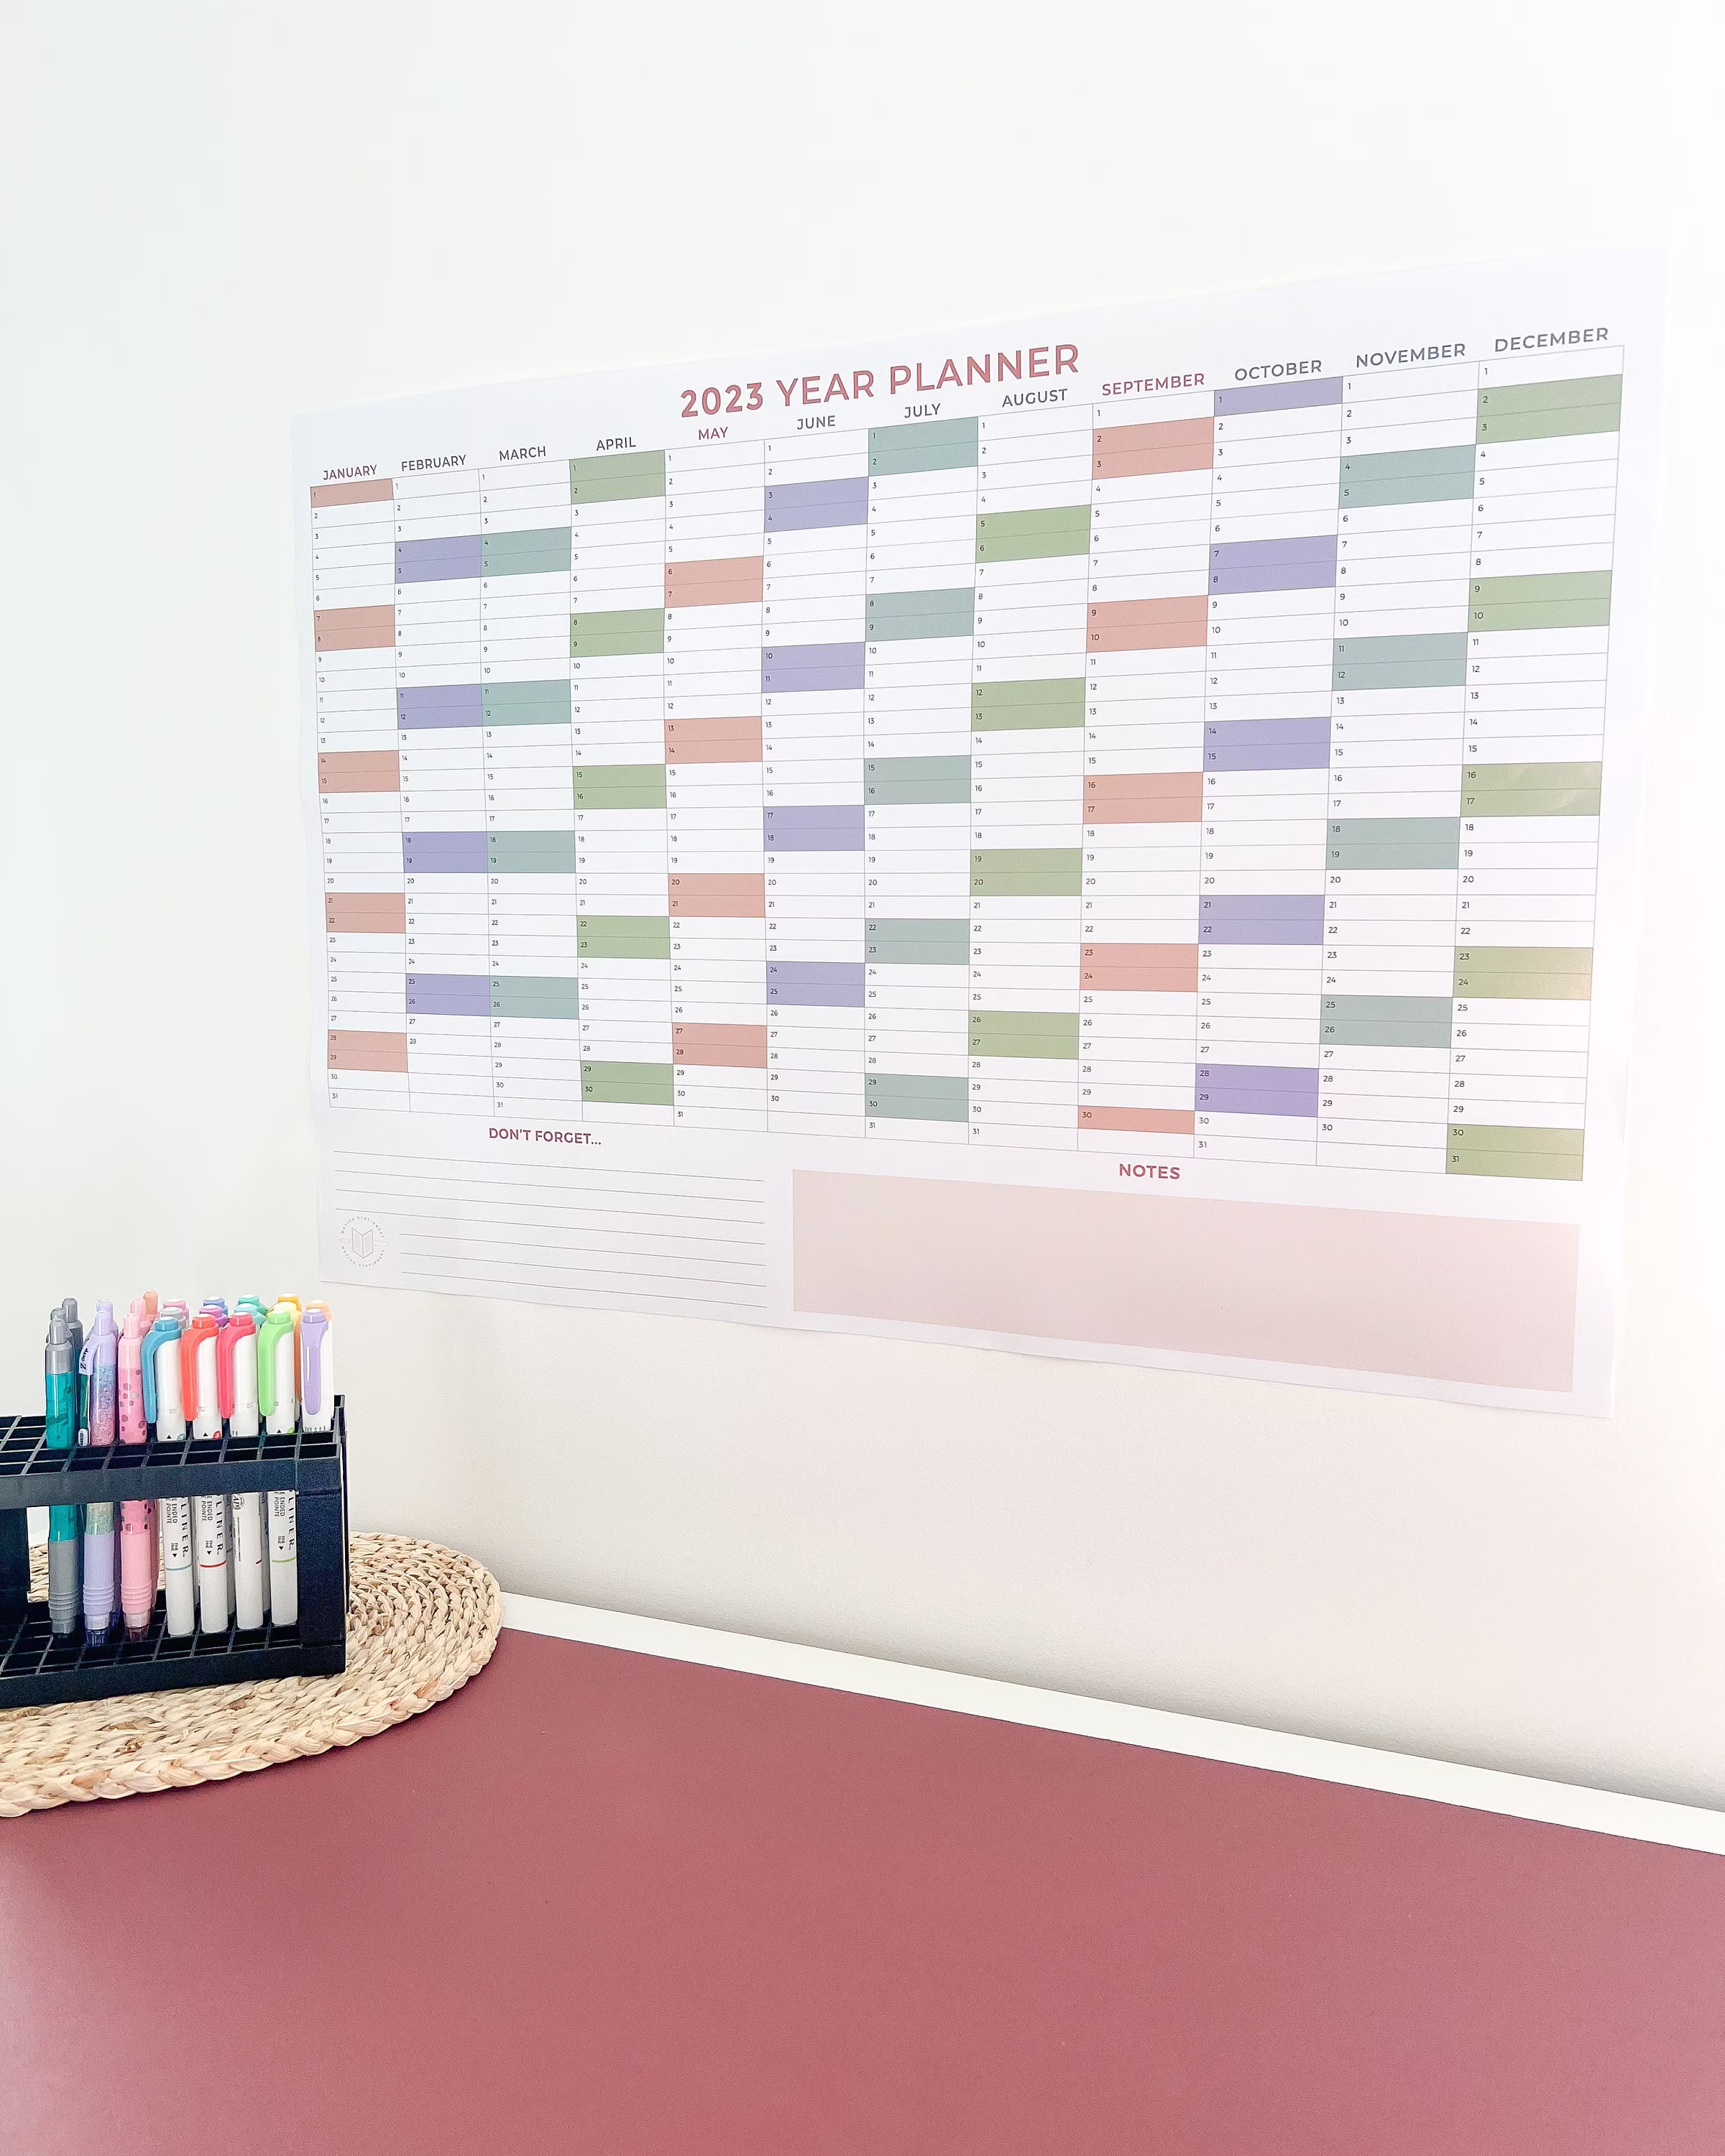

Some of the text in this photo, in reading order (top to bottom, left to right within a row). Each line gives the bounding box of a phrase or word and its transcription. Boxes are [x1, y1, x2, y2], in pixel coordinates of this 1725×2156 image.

[1494, 327, 1609, 353] DECEMBER
[1356, 343, 1466, 369] NOVEMBER
[1234, 359, 1323, 382] OCTOBER
[680, 344, 1080, 418] 2023 YEAR PLANNER
[1102, 373, 1205, 397] SEPTEMBER
[1001, 388, 1068, 408] AUGUST
[904, 402, 942, 419] JULY
[796, 415, 836, 430] JUNE
[698, 426, 728, 441] MAY
[596, 436, 637, 451] APRIL
[499, 446, 546, 461] MARCH
[401, 454, 466, 472] FEBRUARY
[323, 464, 378, 481] JANUARY
[1478, 477, 1485, 486] 5
[1215, 499, 1222, 507] 5
[1475, 558, 1481, 566] 8
[1336, 696, 1345, 705] 13
[1328, 926, 1338, 934] 22
[1457, 1003, 1468, 1012] 25
[489, 1127, 602, 1146] DON'T FORGET...
[1119, 1163, 1180, 1180] NOTES
[180, 1503, 189, 1553] LINER
